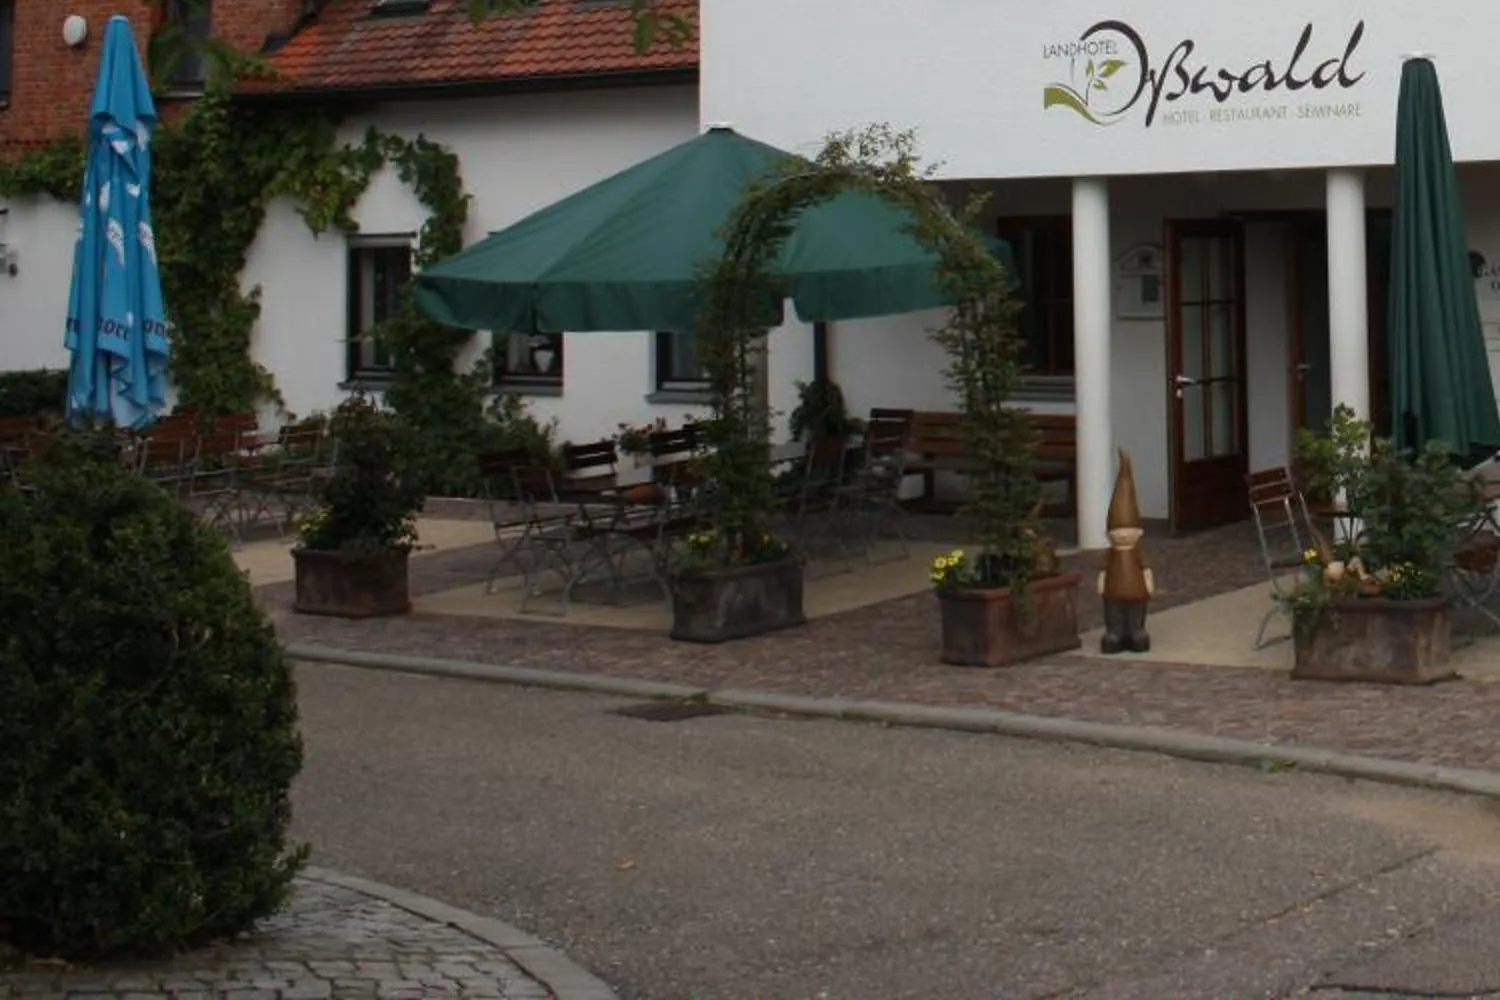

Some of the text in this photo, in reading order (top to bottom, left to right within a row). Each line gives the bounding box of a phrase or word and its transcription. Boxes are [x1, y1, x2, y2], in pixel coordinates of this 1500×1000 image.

[1043, 39, 1119, 59] LANDHOTEL
[1079, 19, 1366, 128] Oßwald
[1209, 104, 1288, 122] RESTAURANT
